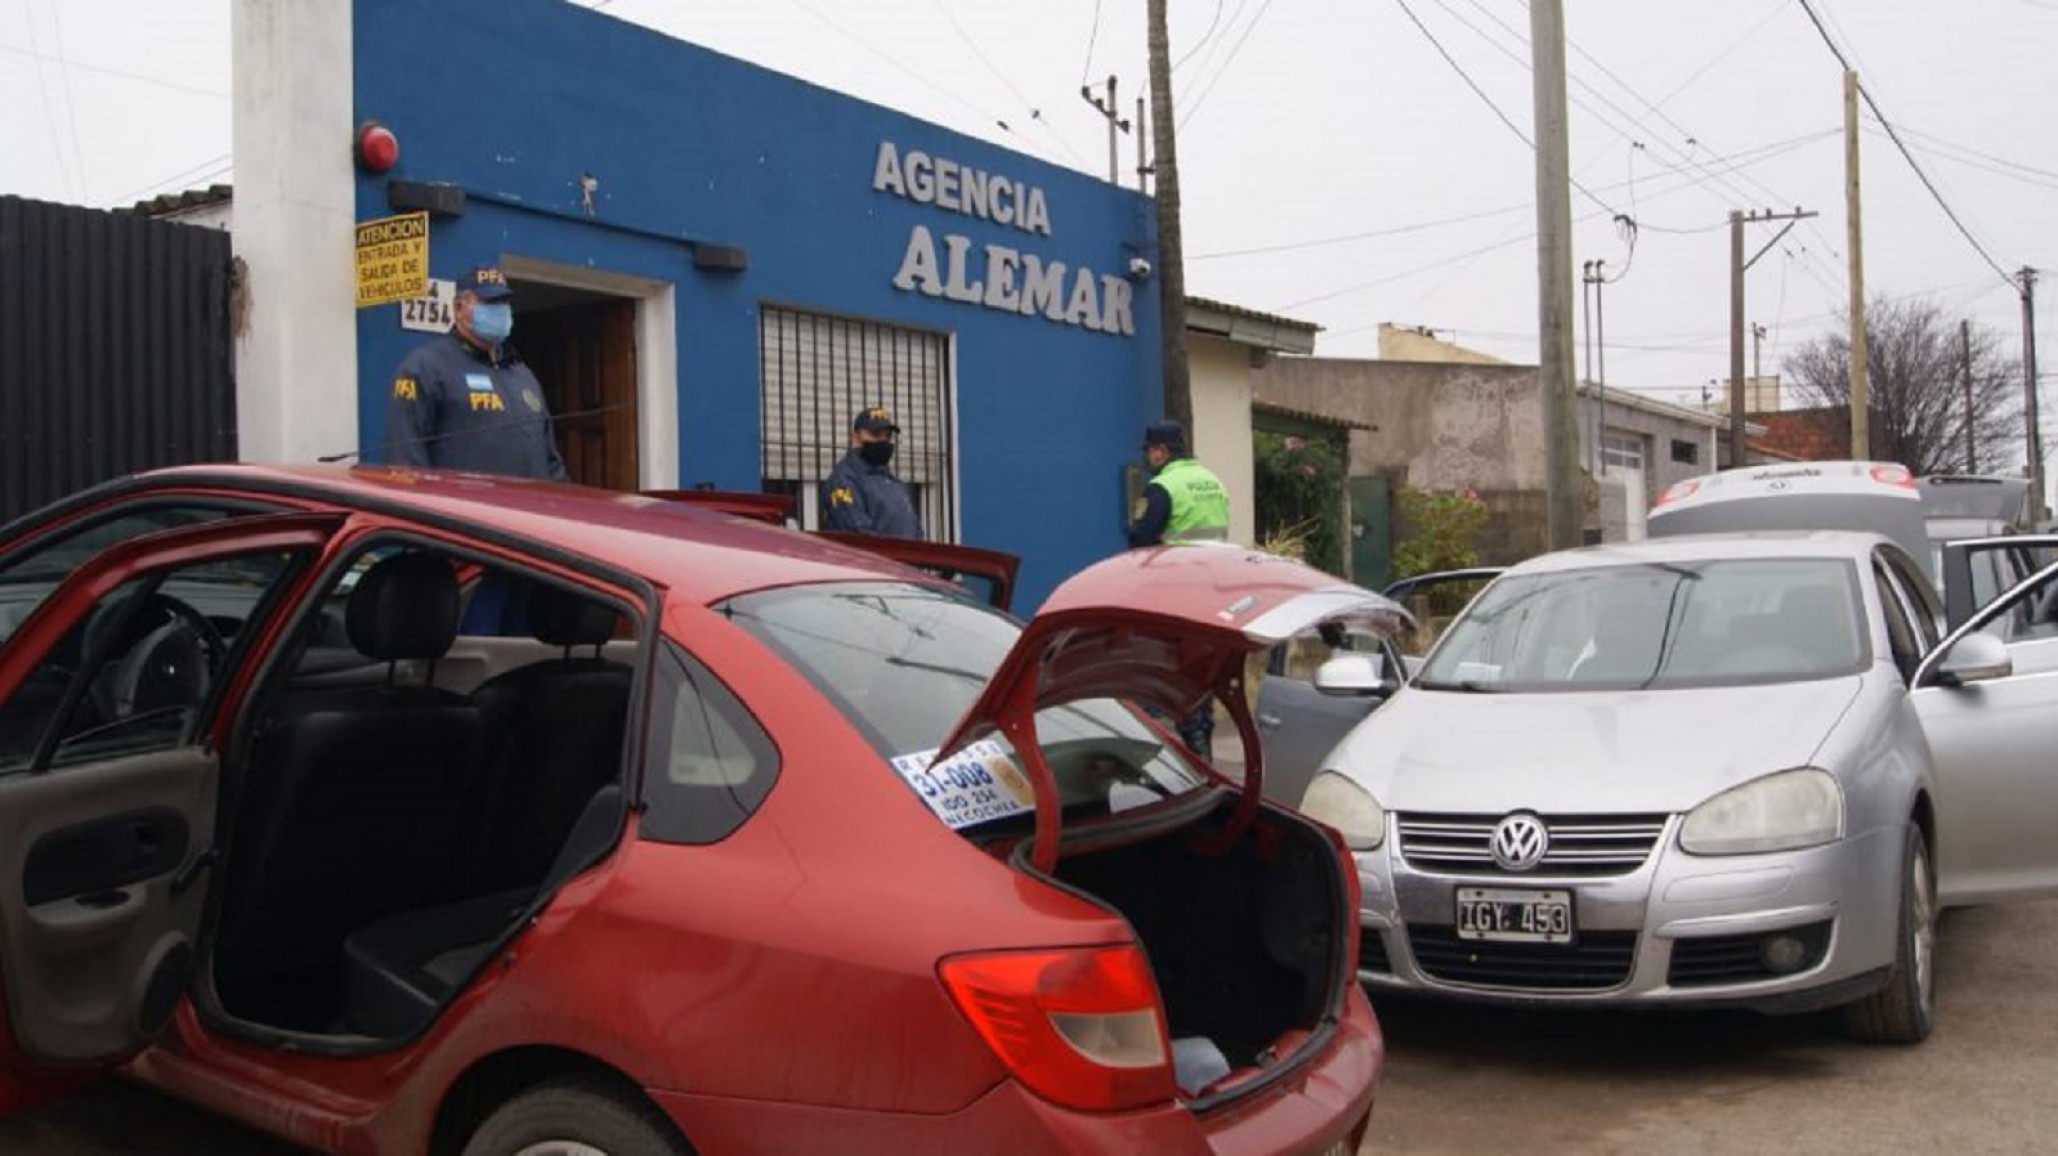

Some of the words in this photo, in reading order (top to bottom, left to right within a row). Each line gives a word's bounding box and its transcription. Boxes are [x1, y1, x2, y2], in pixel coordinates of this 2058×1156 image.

[872, 142, 1051, 235] AGENCIA
[358, 219, 424, 246] ATENCION
[358, 244, 408, 264] ENTRADA
[402, 259, 418, 273] DE
[892, 225, 1135, 335] ALEMAR
[405, 299, 451, 324] 2754
[469, 392, 504, 410] PFA
[913, 761, 994, 797] 31-008
[1521, 903, 1567, 933] 453
